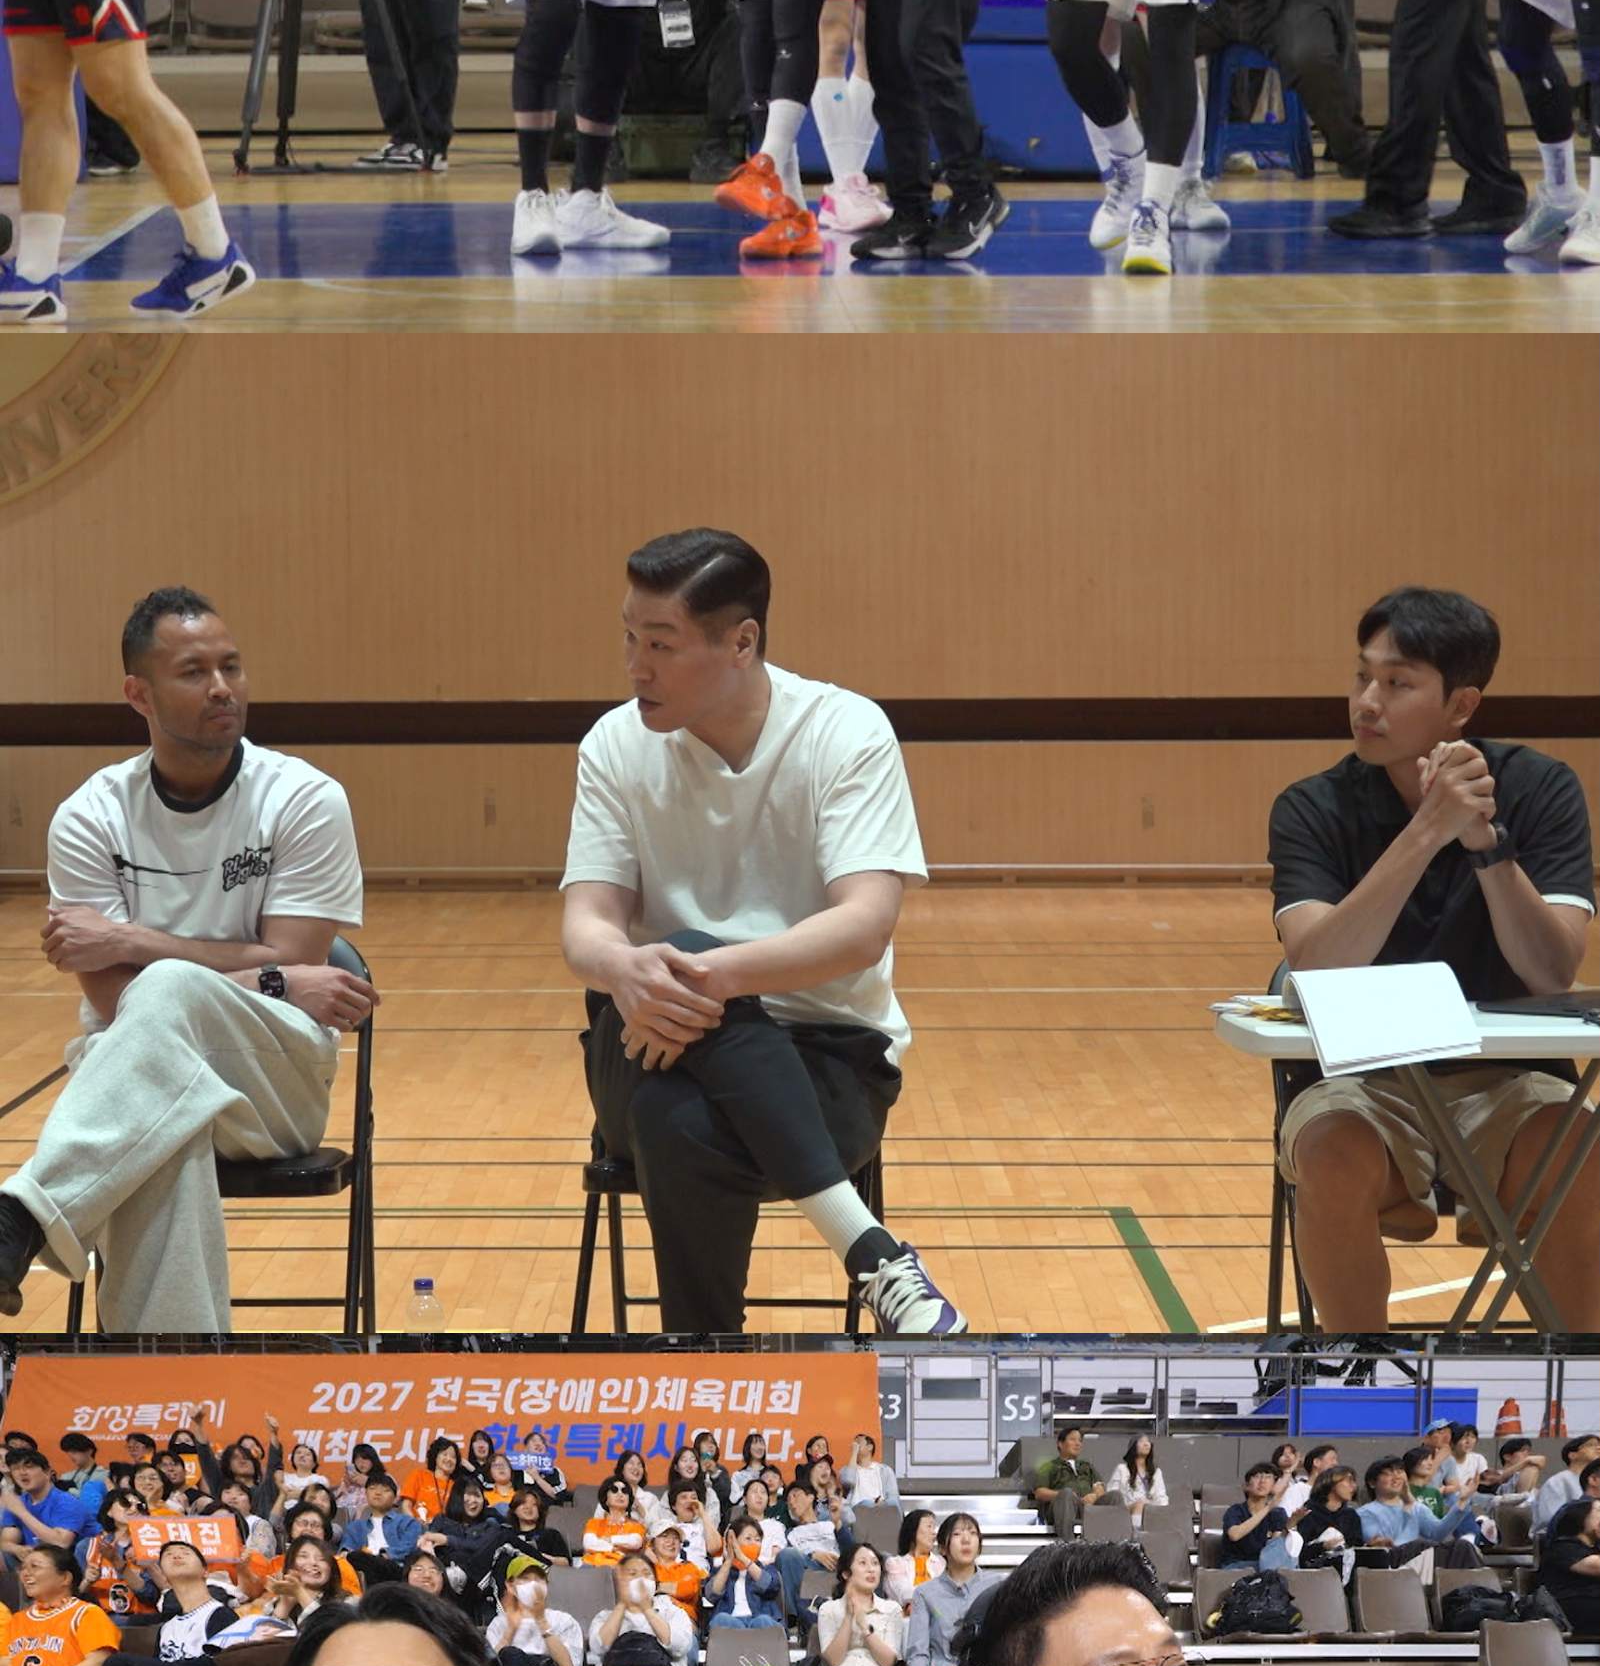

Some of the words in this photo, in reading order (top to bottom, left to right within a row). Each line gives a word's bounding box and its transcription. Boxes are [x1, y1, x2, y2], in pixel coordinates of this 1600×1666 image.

[309, 1380, 414, 1414] 2027
[424, 1376, 802, 1416] 전국(장애인)체육대회
[1001, 1394, 1037, 1422] S5
[137, 1522, 221, 1547] 손태진
